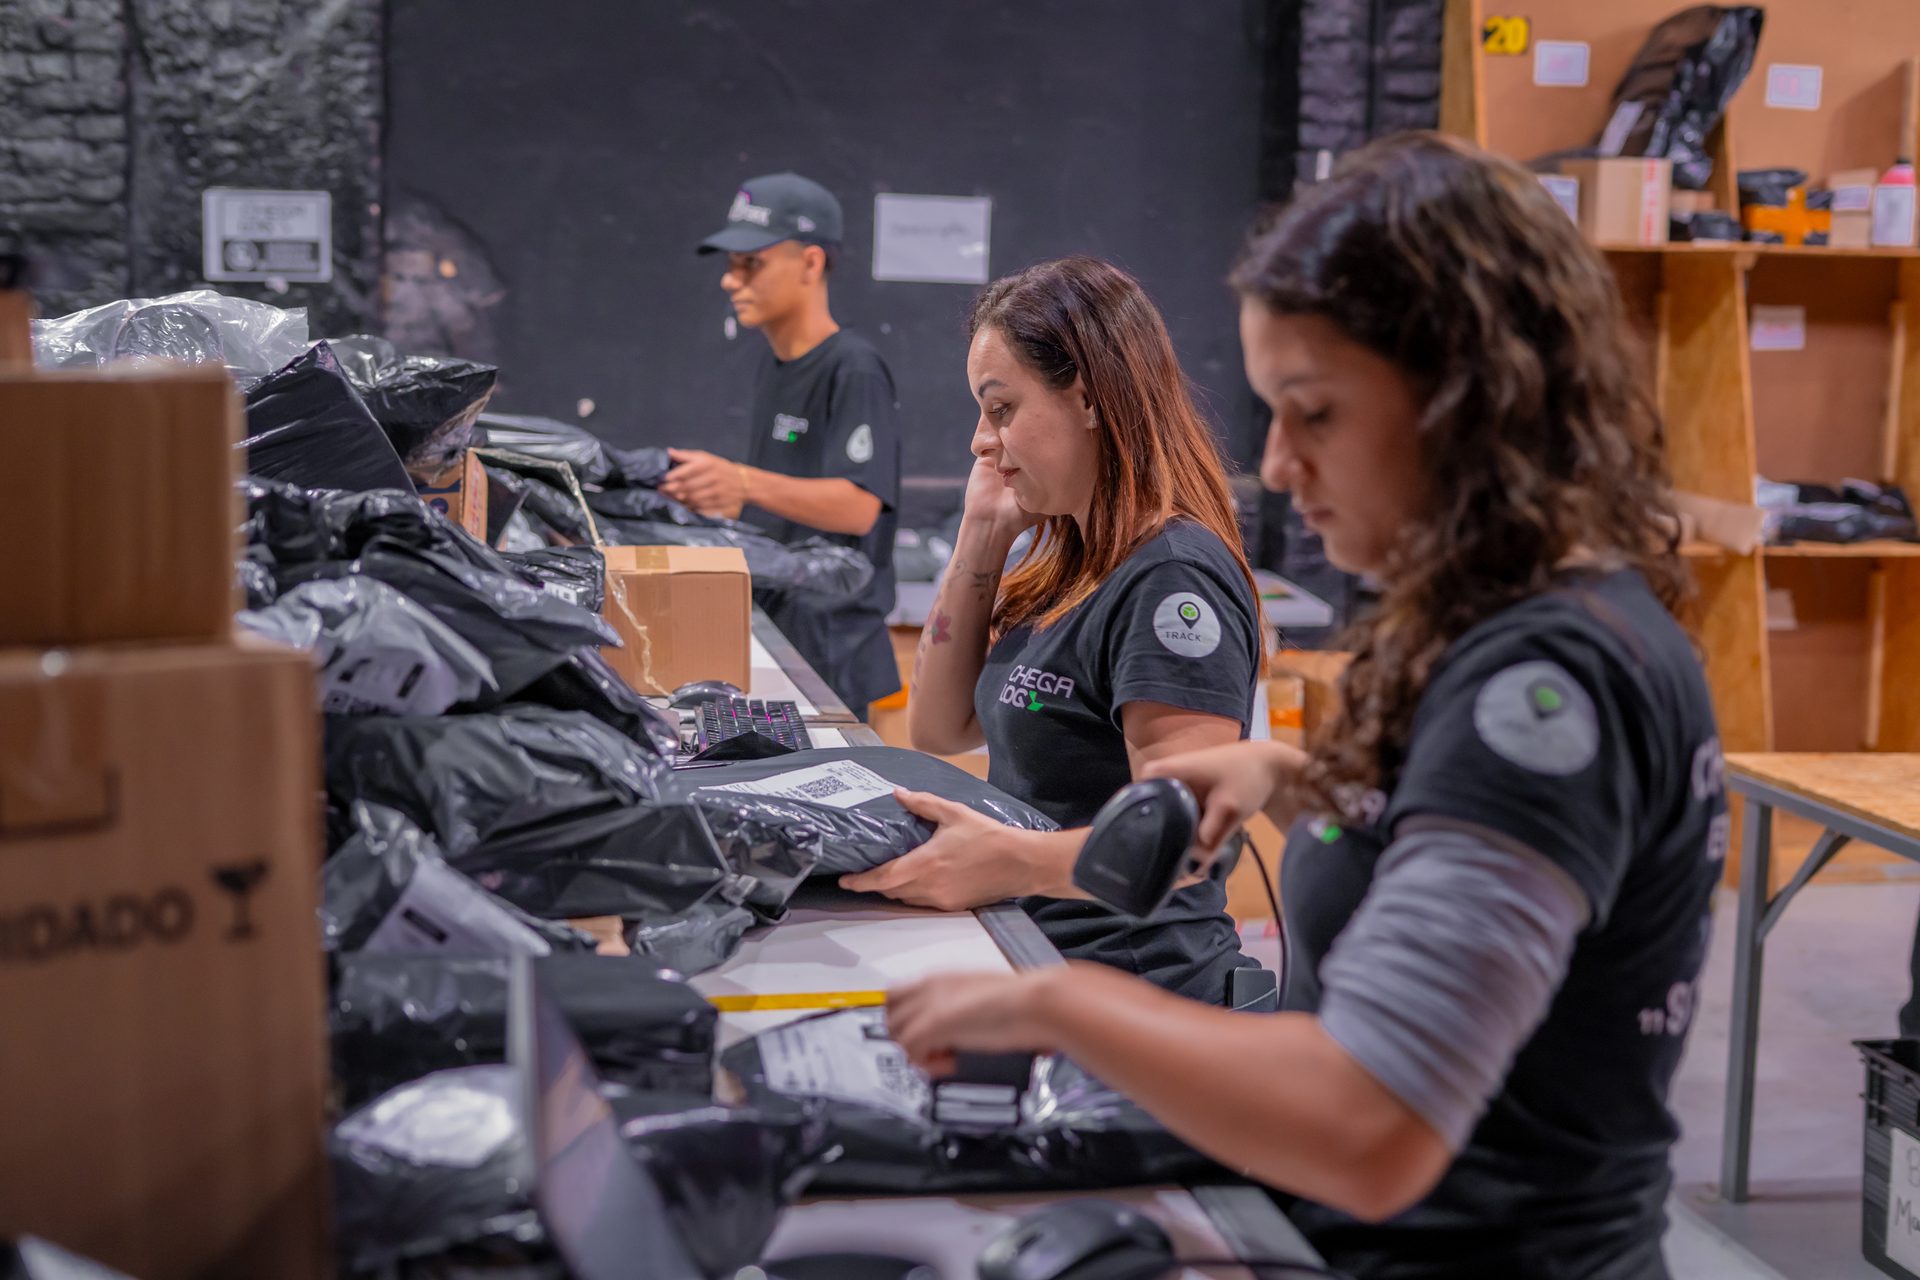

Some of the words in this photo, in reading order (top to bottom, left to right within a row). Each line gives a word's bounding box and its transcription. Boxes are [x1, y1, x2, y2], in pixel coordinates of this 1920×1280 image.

[1484, 16, 1528, 54] 20
[1165, 631, 1201, 642] TRACK
[1009, 664, 1075, 699] CHEGA
